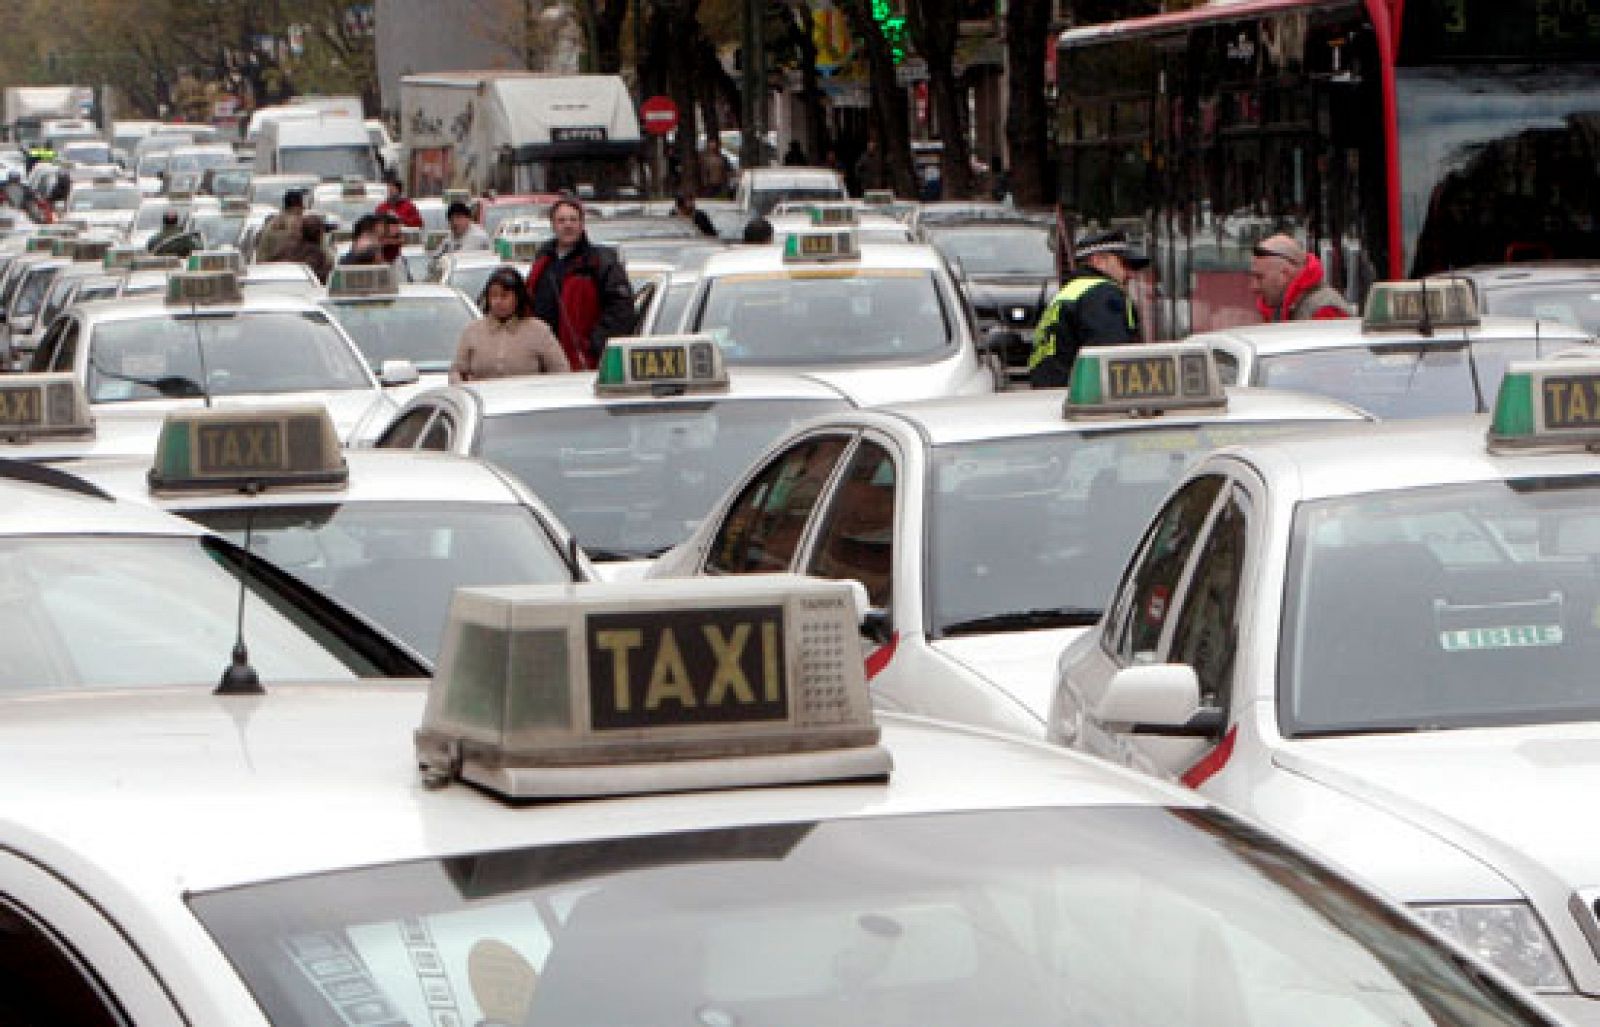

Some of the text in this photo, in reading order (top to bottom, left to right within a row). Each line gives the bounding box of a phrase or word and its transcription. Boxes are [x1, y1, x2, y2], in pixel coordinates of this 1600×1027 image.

[632, 350, 686, 377] TAXI
[1111, 360, 1174, 394] TAXI
[205, 430, 279, 468] TAXI
[596, 622, 780, 713] TAXI
